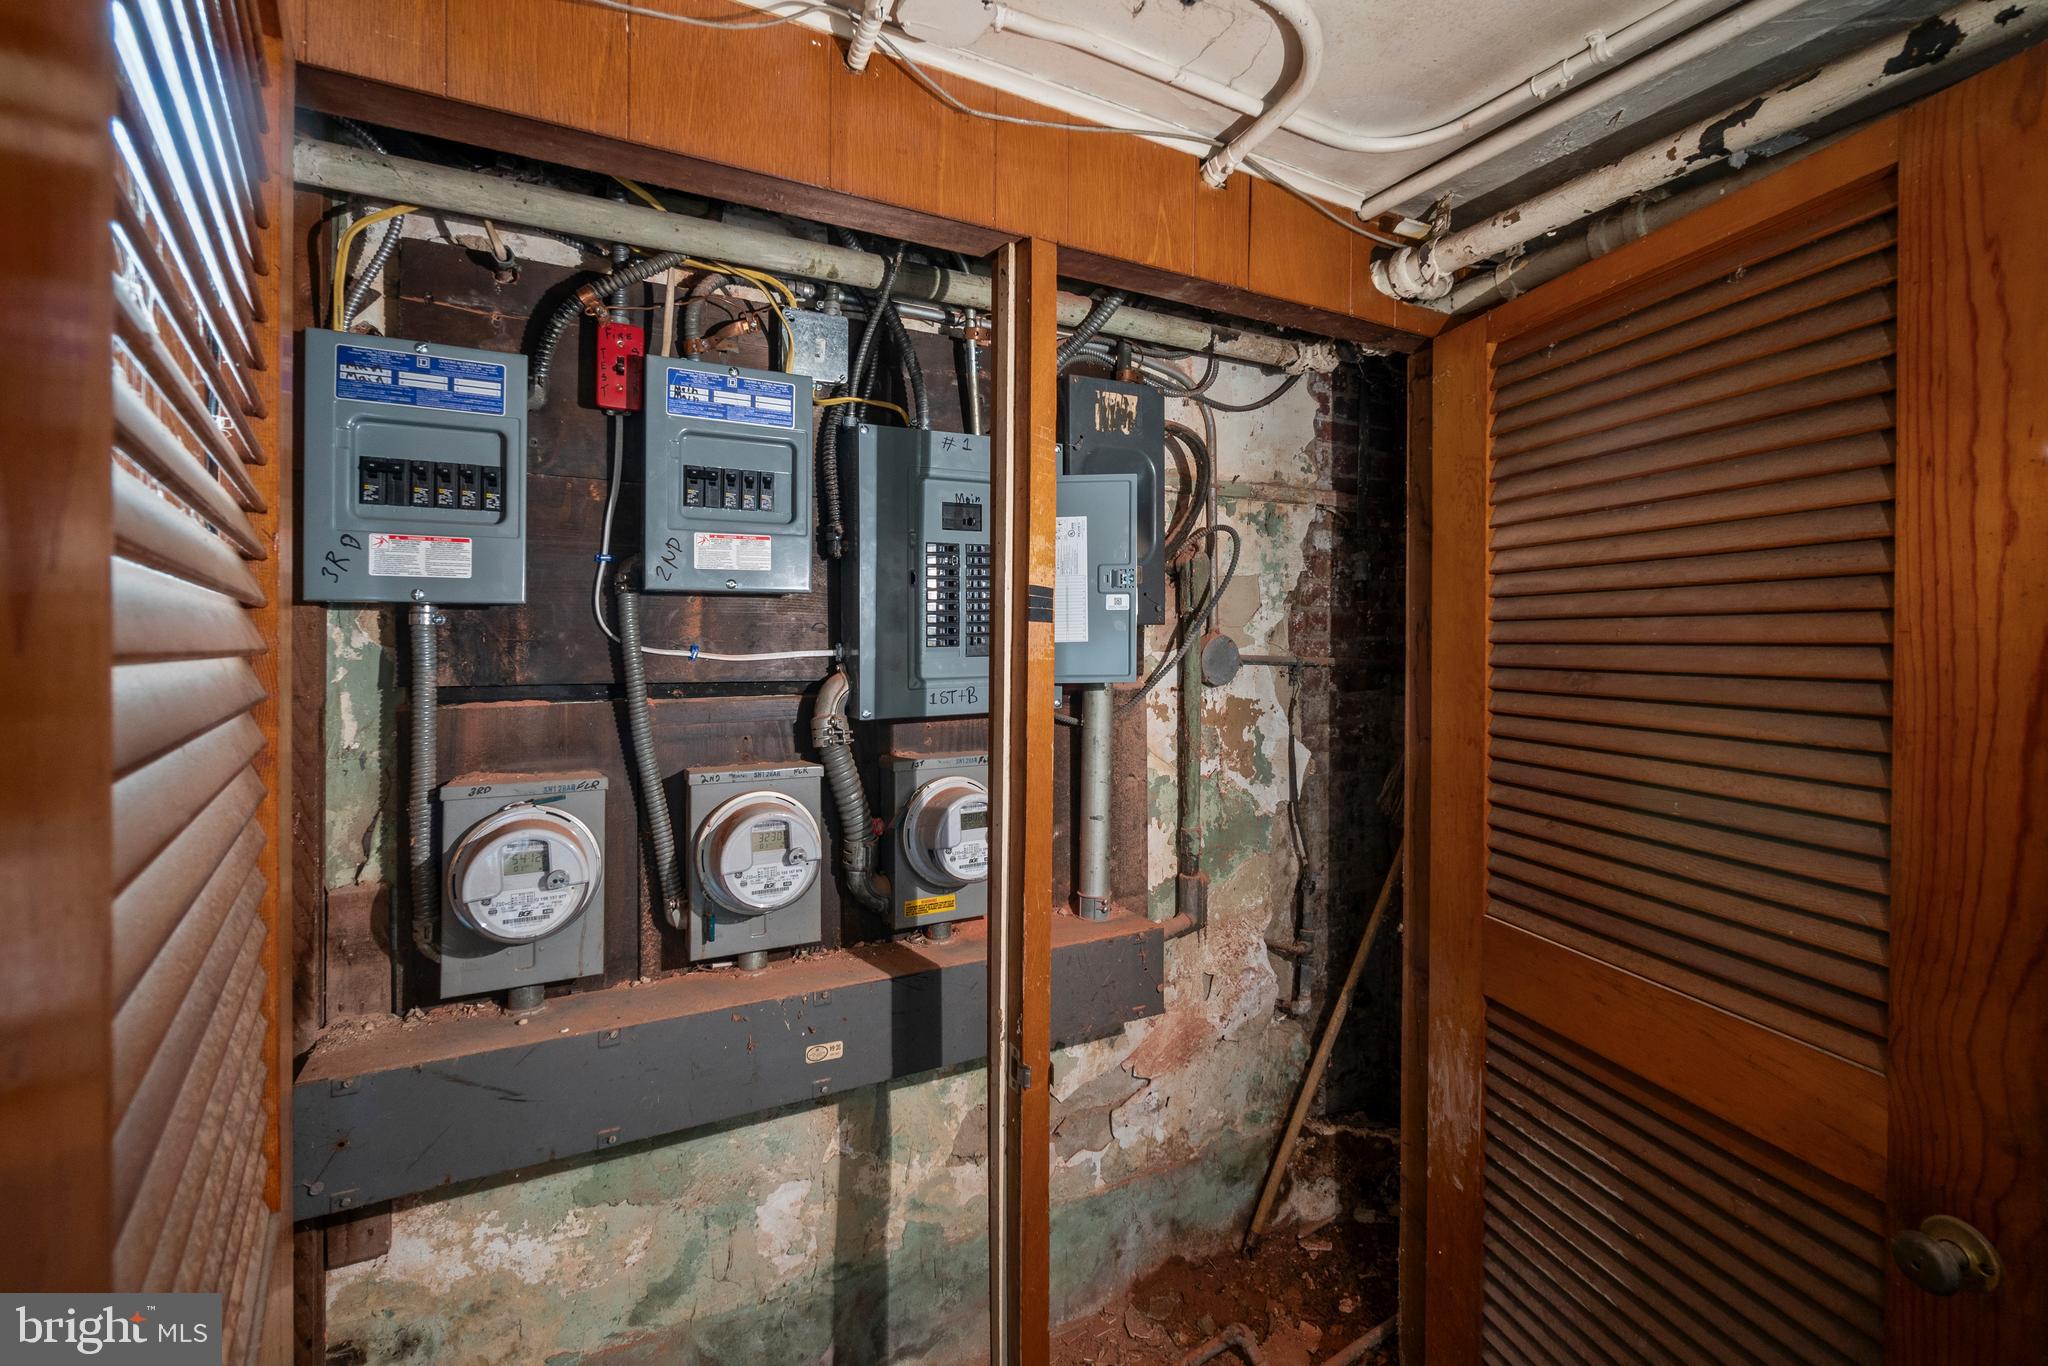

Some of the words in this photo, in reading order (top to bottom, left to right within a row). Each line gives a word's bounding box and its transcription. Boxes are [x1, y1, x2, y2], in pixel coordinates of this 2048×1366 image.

[321, 533, 362, 584] 3RD
[655, 537, 683, 581] 2ND
[700, 774, 721, 784] 2ND
[576, 780, 600, 791] FLR
[468, 786, 492, 797] 3RD
